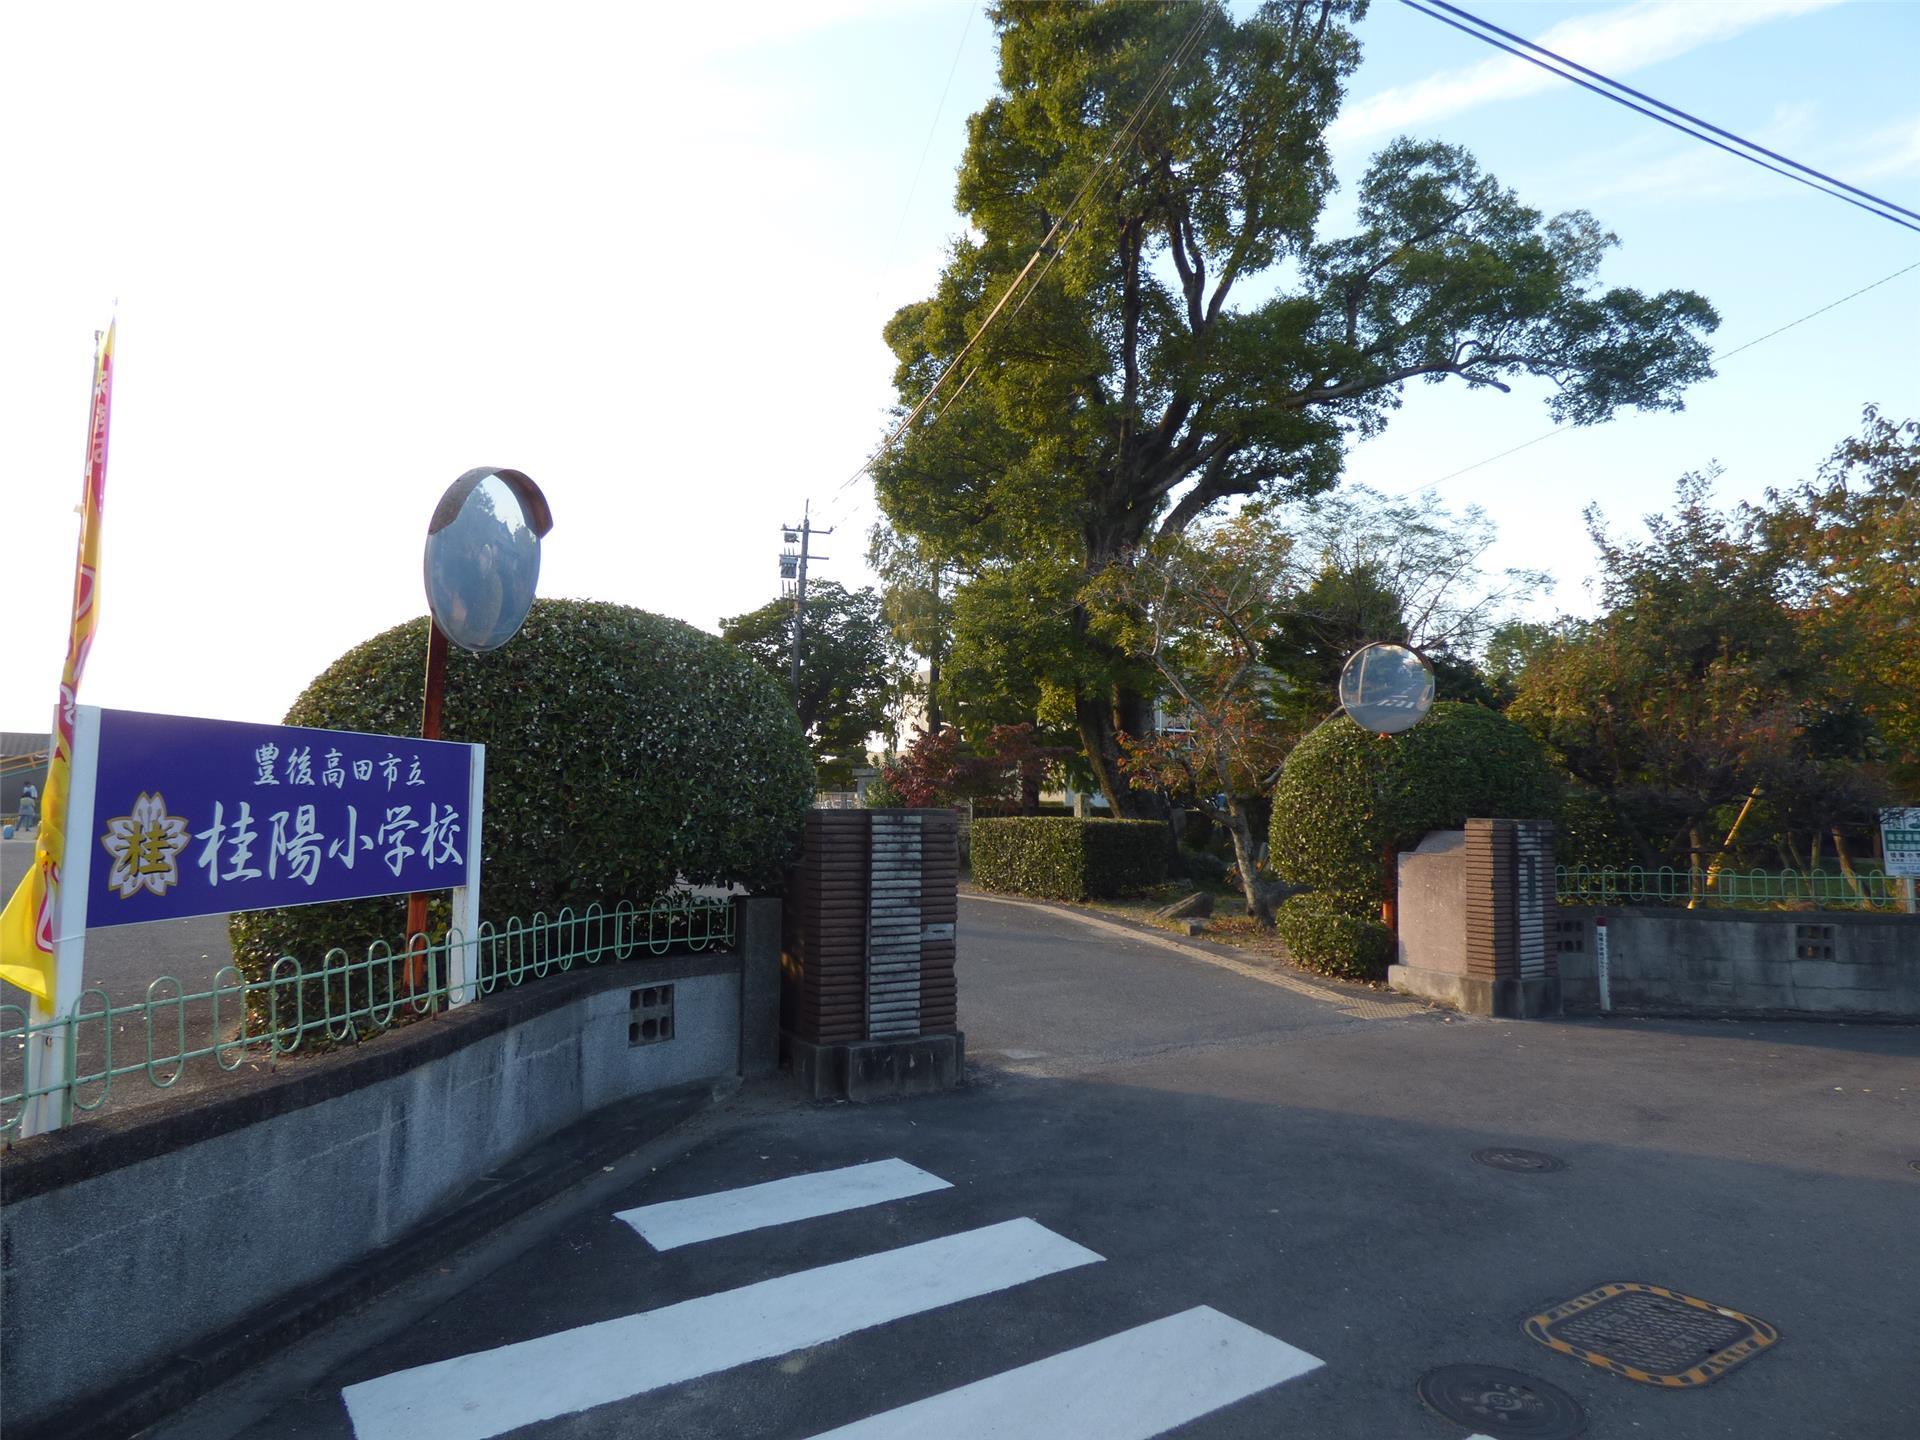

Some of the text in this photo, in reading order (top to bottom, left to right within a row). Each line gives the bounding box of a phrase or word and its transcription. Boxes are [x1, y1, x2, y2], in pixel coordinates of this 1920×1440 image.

[121, 822, 171, 876] 桂
[195, 800, 463, 887] 桂陽小学校
